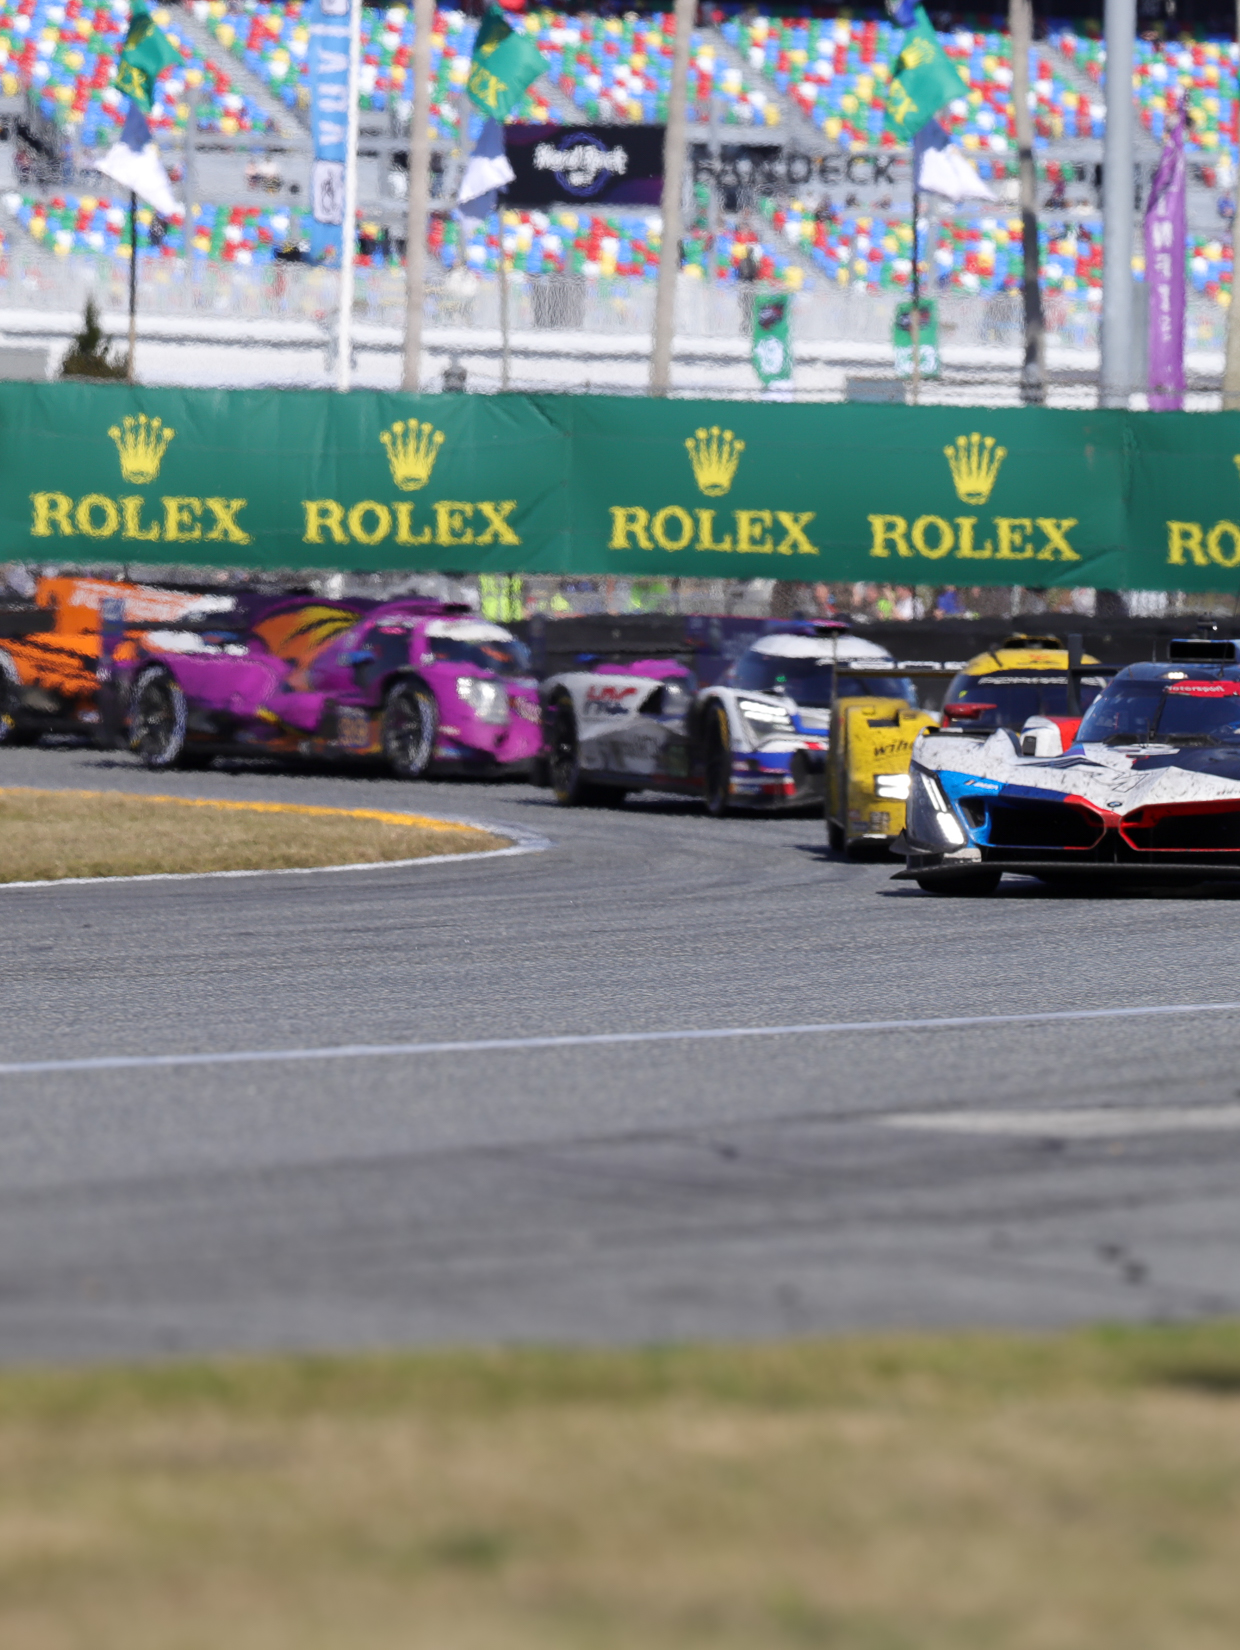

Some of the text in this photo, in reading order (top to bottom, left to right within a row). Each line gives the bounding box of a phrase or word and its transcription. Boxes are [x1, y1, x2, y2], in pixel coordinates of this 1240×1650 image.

[29, 490, 251, 545] ROLEX
[301, 498, 521, 547] ROLEX
[608, 505, 819, 556] ROLEX
[866, 513, 1081, 561] ROLEX
